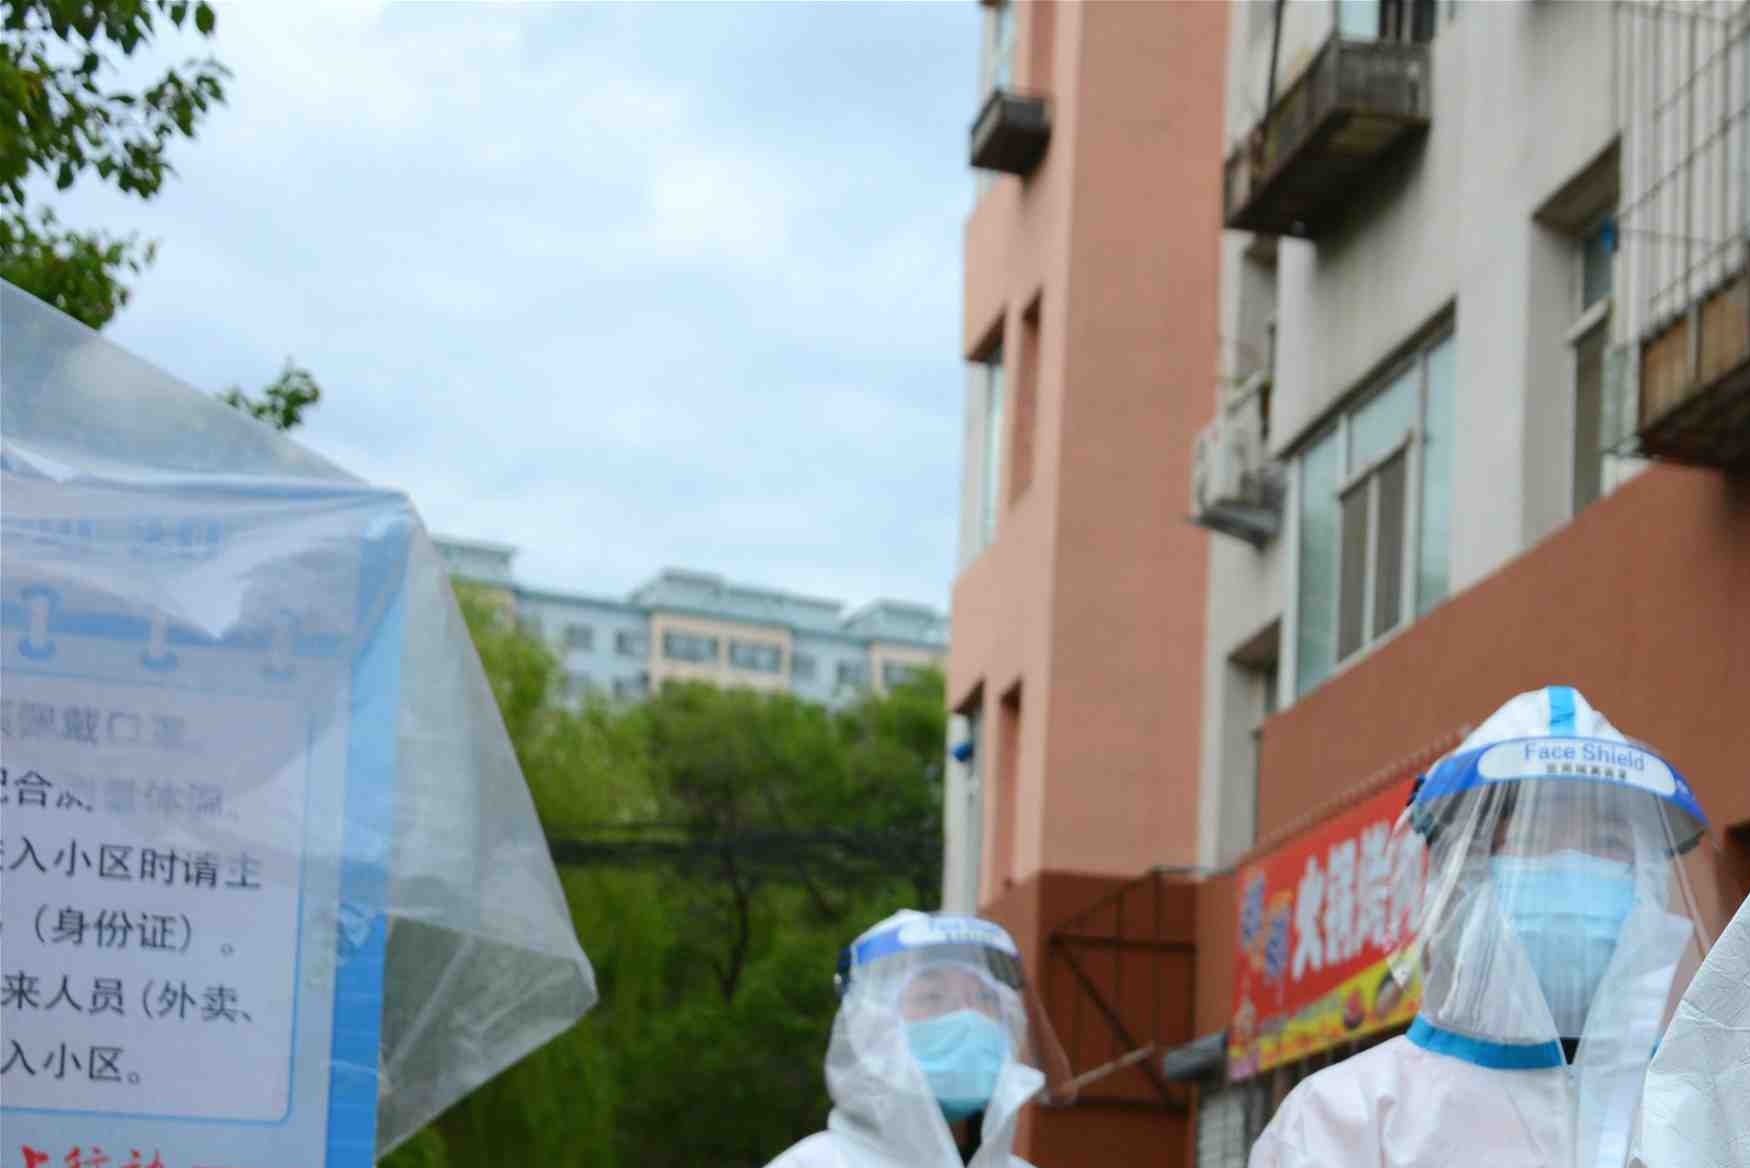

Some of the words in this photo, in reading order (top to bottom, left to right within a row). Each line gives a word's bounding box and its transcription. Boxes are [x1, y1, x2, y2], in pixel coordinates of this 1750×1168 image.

[1523, 743, 1576, 761] Face
[1584, 744, 1646, 771] Shield
[0, 836, 262, 889] 入小区时请主
